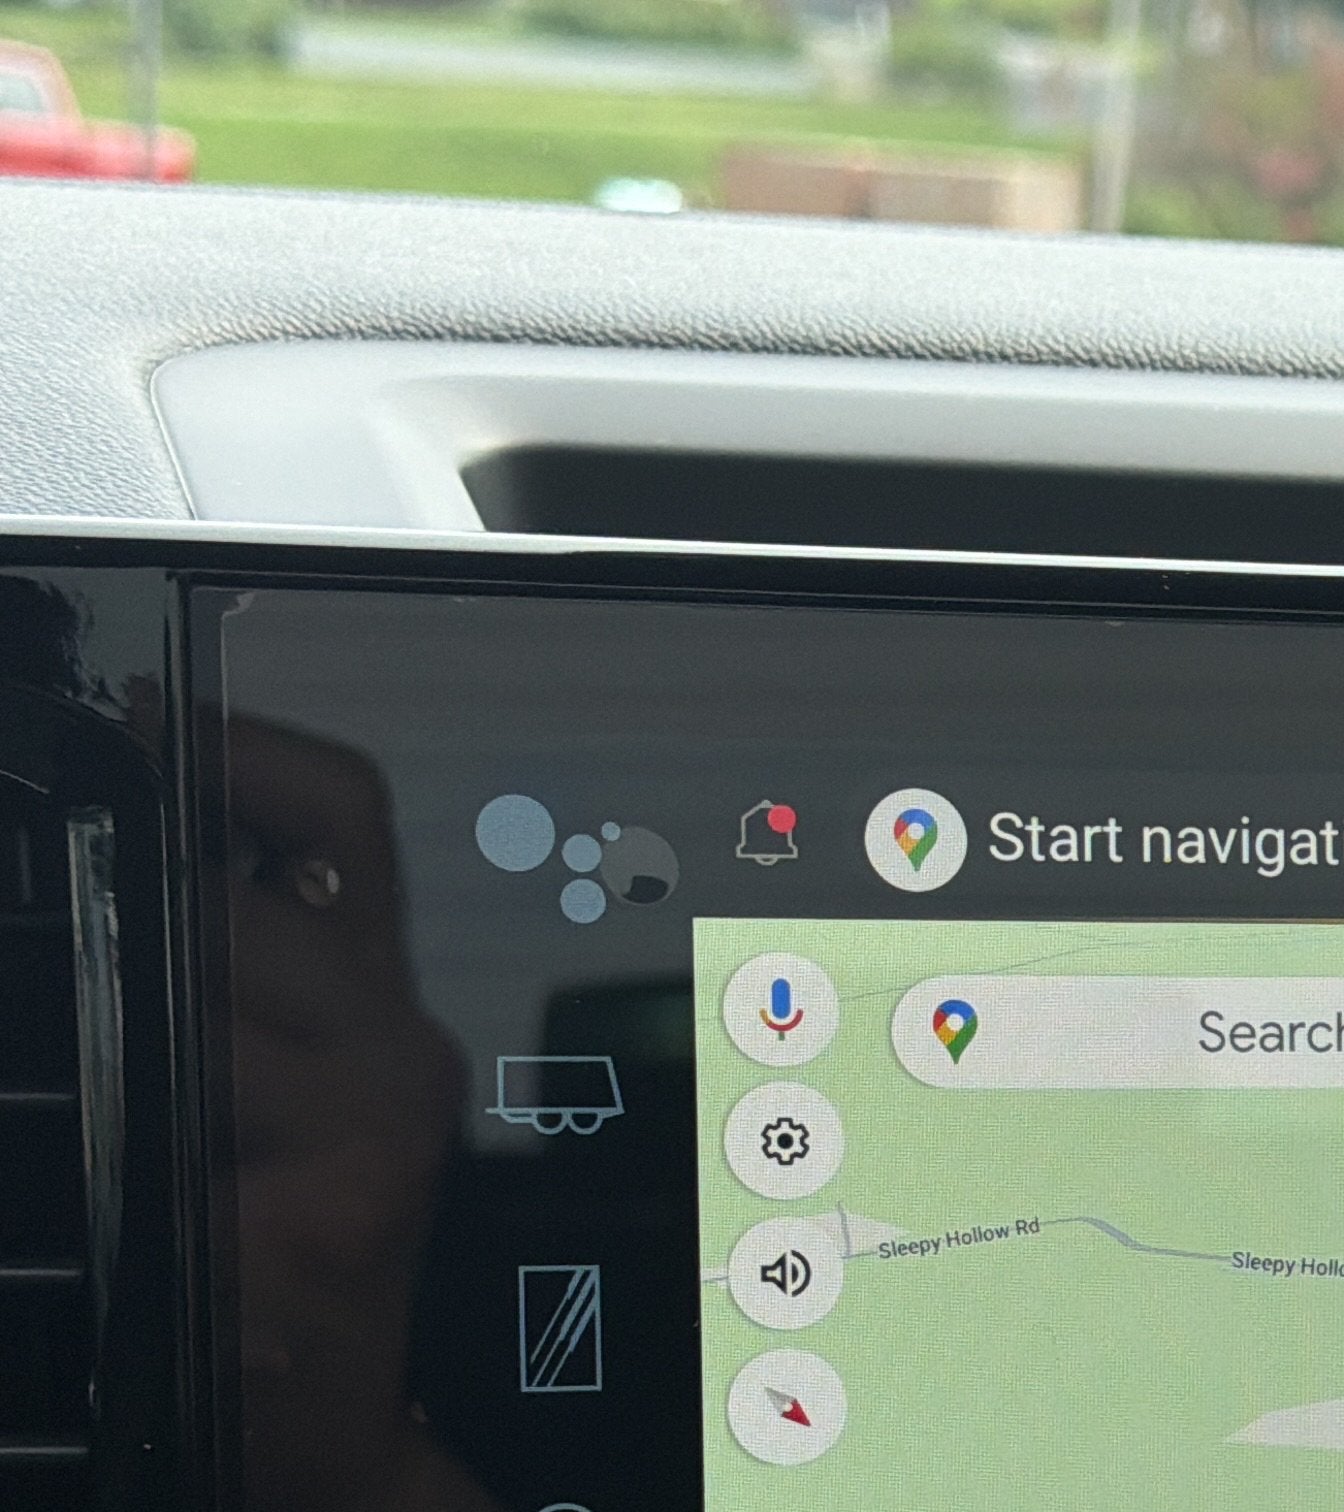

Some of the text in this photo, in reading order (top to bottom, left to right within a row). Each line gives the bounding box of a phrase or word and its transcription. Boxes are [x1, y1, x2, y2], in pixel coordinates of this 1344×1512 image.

[988, 812, 1124, 865] Start
[878, 1216, 1042, 1261] Sleepy Hollow Rd
[1231, 1252, 1296, 1278] Sleepy
